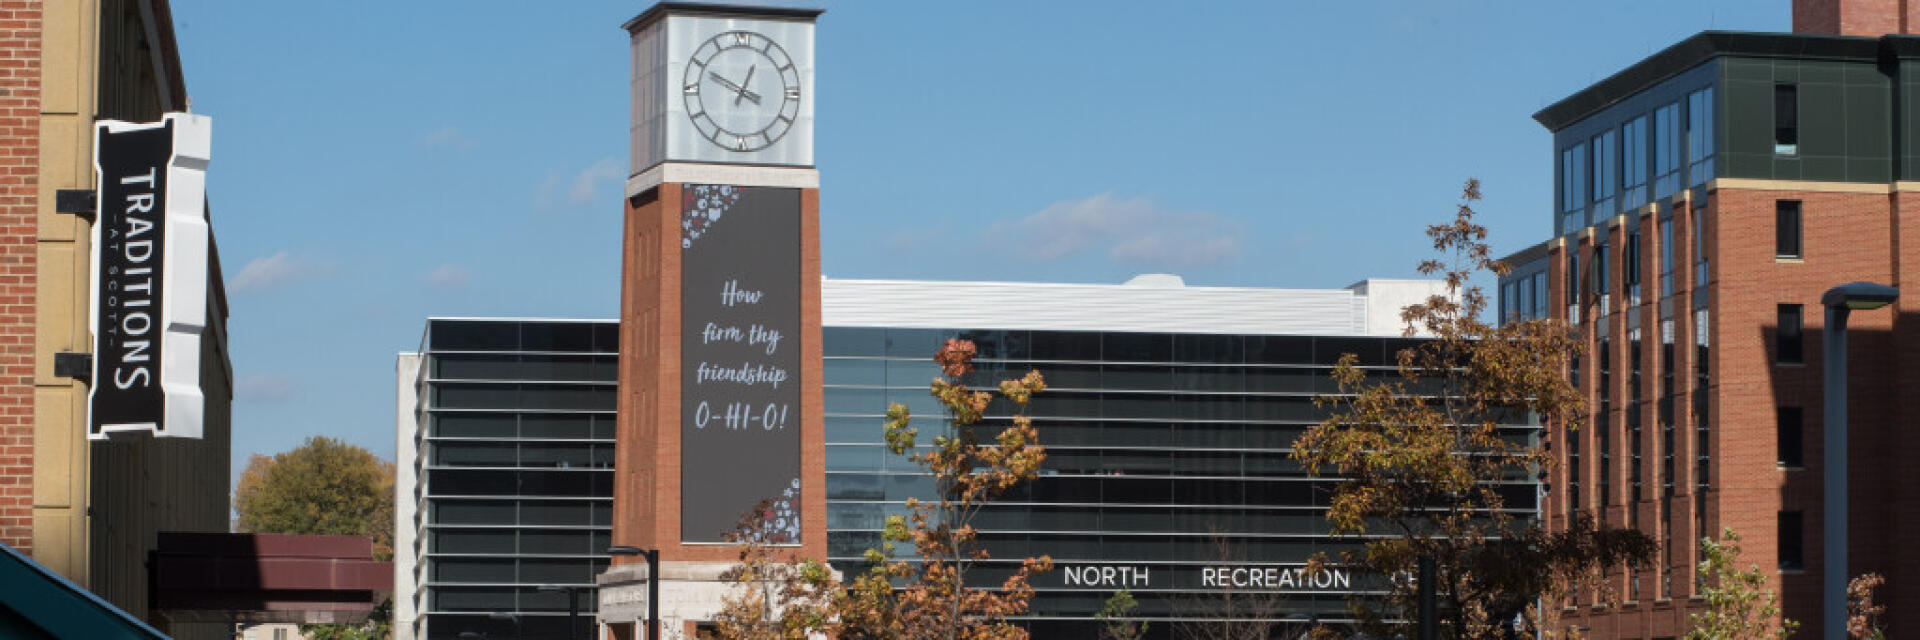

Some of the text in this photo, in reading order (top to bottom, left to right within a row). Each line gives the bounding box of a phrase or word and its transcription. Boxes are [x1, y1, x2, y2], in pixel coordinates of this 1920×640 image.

[114, 166, 157, 390] TRADITIONS
[720, 279, 764, 307] How
[702, 322, 784, 355] firm thy
[696, 361, 788, 389] friendship
[695, 400, 788, 431] O-HI-O!
[1064, 566, 1351, 589] NORTH RECREATION
